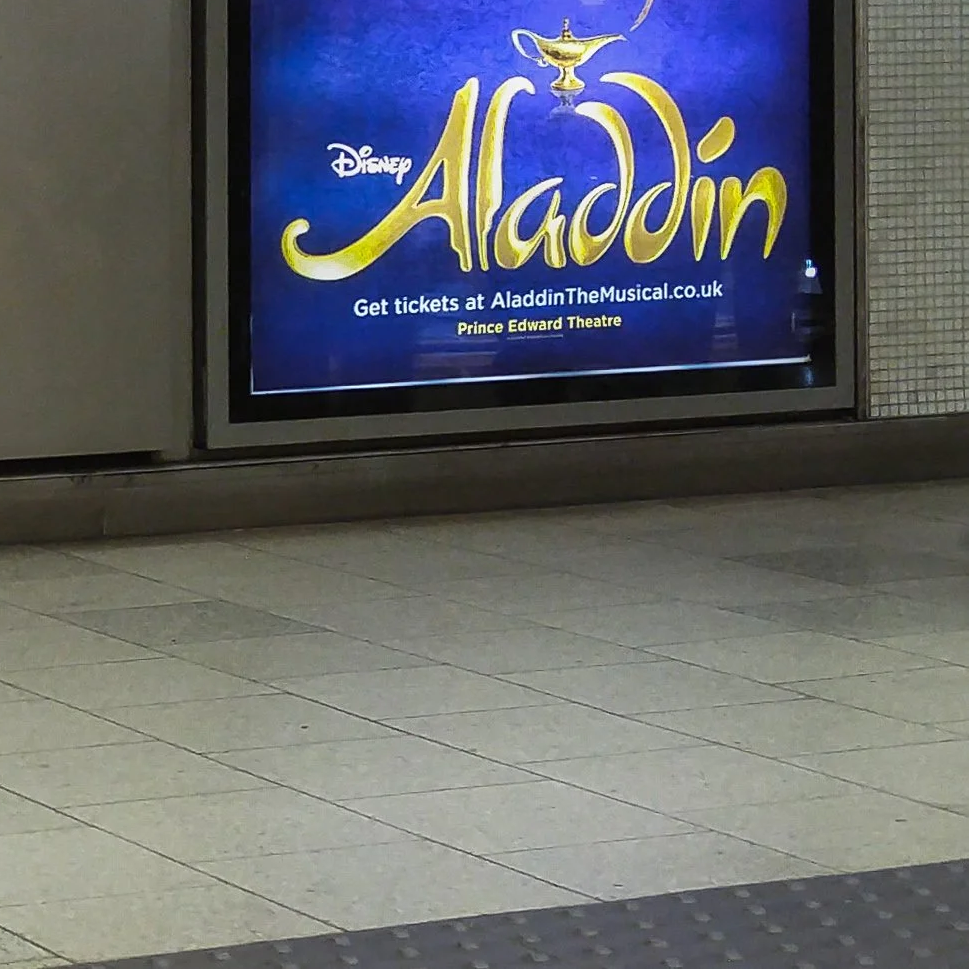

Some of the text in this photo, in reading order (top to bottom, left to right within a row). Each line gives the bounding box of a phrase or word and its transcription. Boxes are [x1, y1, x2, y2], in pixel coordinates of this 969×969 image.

[281, 71, 787, 281] Aladdin
[354, 280, 723, 317] Get tickets at AladdinTheMusical.co.uk
[457, 314, 622, 335] Prince Edward Theatre
